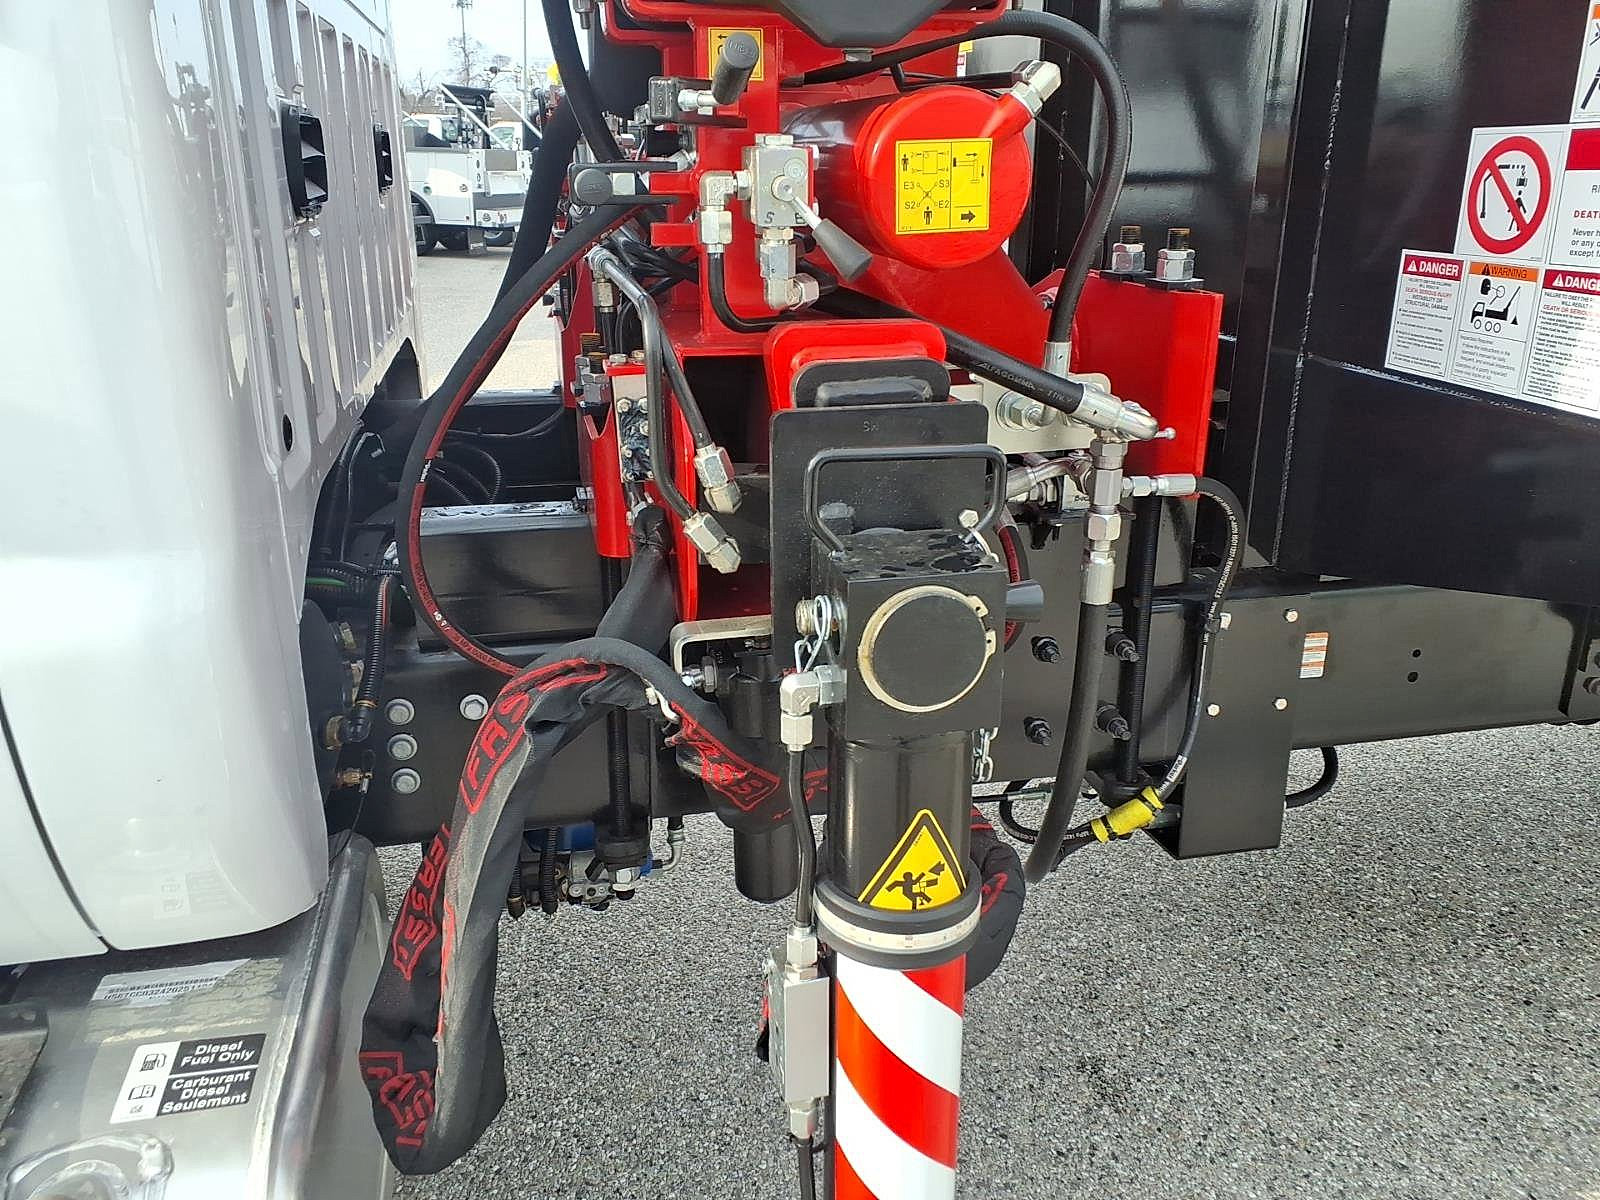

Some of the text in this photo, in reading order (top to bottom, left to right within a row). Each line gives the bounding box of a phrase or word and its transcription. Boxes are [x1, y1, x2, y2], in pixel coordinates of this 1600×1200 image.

[903, 179, 950, 190] E3 S3
[904, 200, 950, 210] S2 E2
[1573, 209, 1600, 219] DEAT
[1572, 227, 1594, 237] Never
[1569, 249, 1594, 258] except
[1419, 260, 1460, 277] DANGER
[1491, 265, 1528, 279] WARNING
[194, 1040, 243, 1056] Diesel
[180, 1048, 256, 1068] Fuel Only
[171, 1070, 251, 1090] Carburant
[180, 1083, 231, 1100] Diesel
[161, 1092, 249, 1113] Seulement
